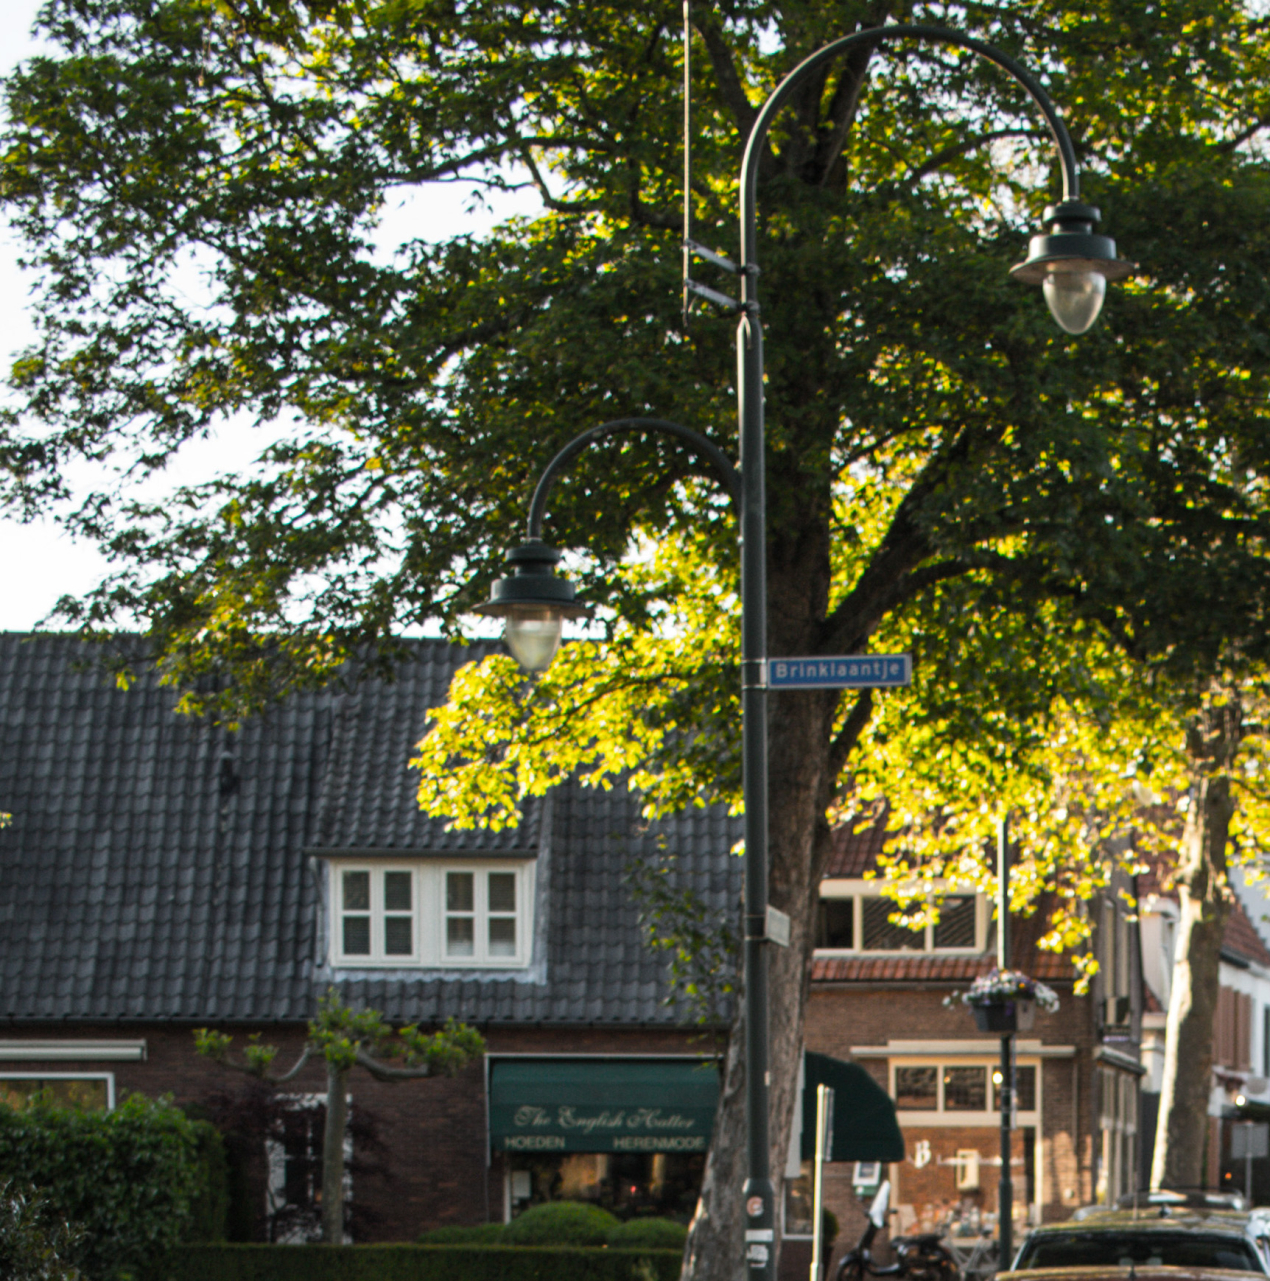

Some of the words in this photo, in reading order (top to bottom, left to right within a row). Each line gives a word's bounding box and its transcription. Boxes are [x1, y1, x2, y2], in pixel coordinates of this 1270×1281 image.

[775, 661, 900, 680] Brinklaantje
[513, 1105, 550, 1127] The
[557, 1105, 626, 1134] English
[626, 1107, 695, 1129] Hatter
[504, 1136, 565, 1148] HOEDEN
